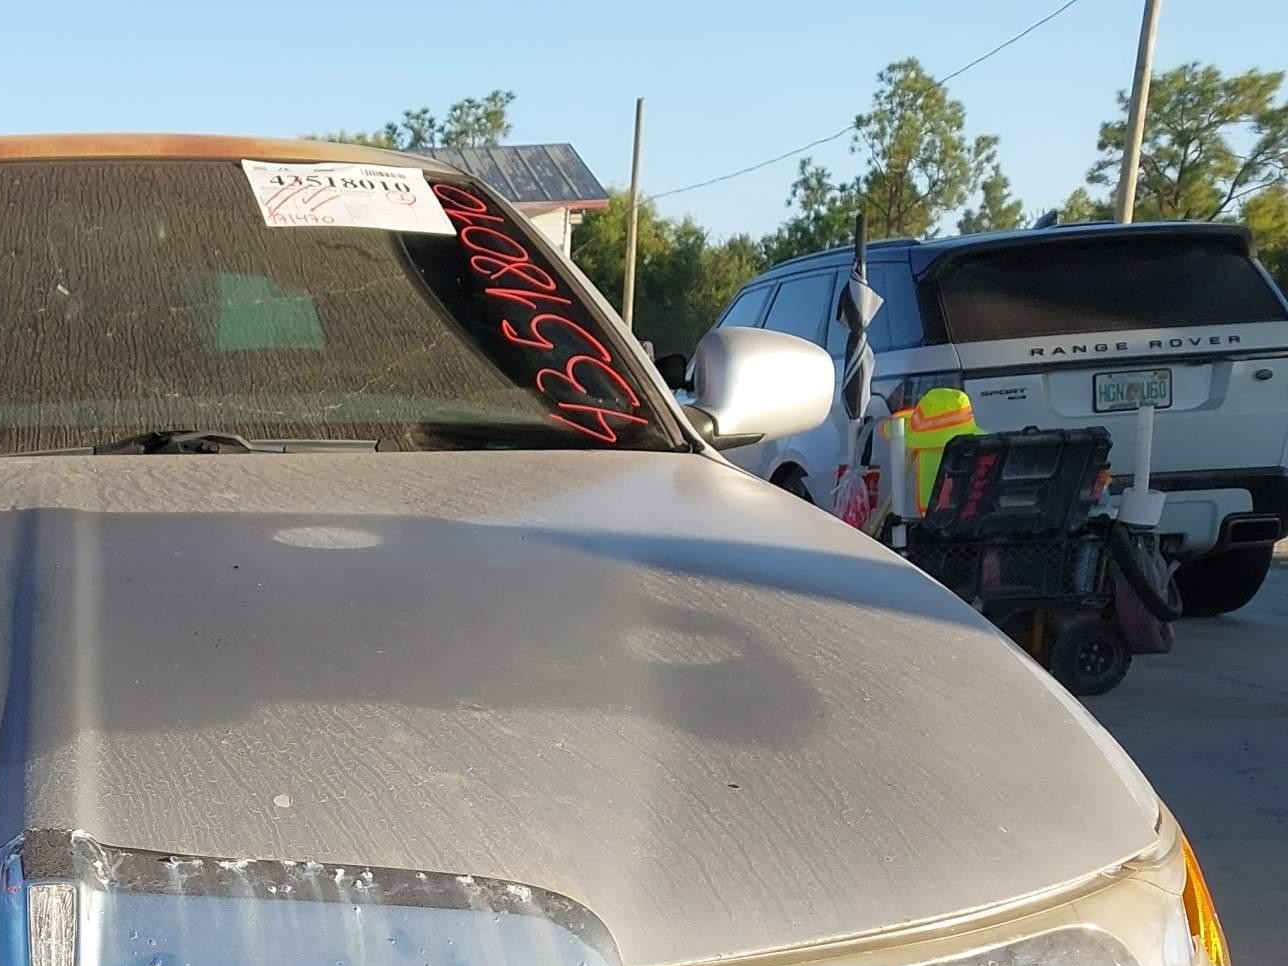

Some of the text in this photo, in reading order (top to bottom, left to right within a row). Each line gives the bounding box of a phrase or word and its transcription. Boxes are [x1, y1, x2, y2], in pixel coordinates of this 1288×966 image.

[269, 174, 411, 193] 43518010
[432, 183, 649, 443] 43518010
[1030, 335, 1242, 357] RANGE ROVER
[979, 387, 1028, 397] SPORT
[1098, 382, 1125, 402] HGN
